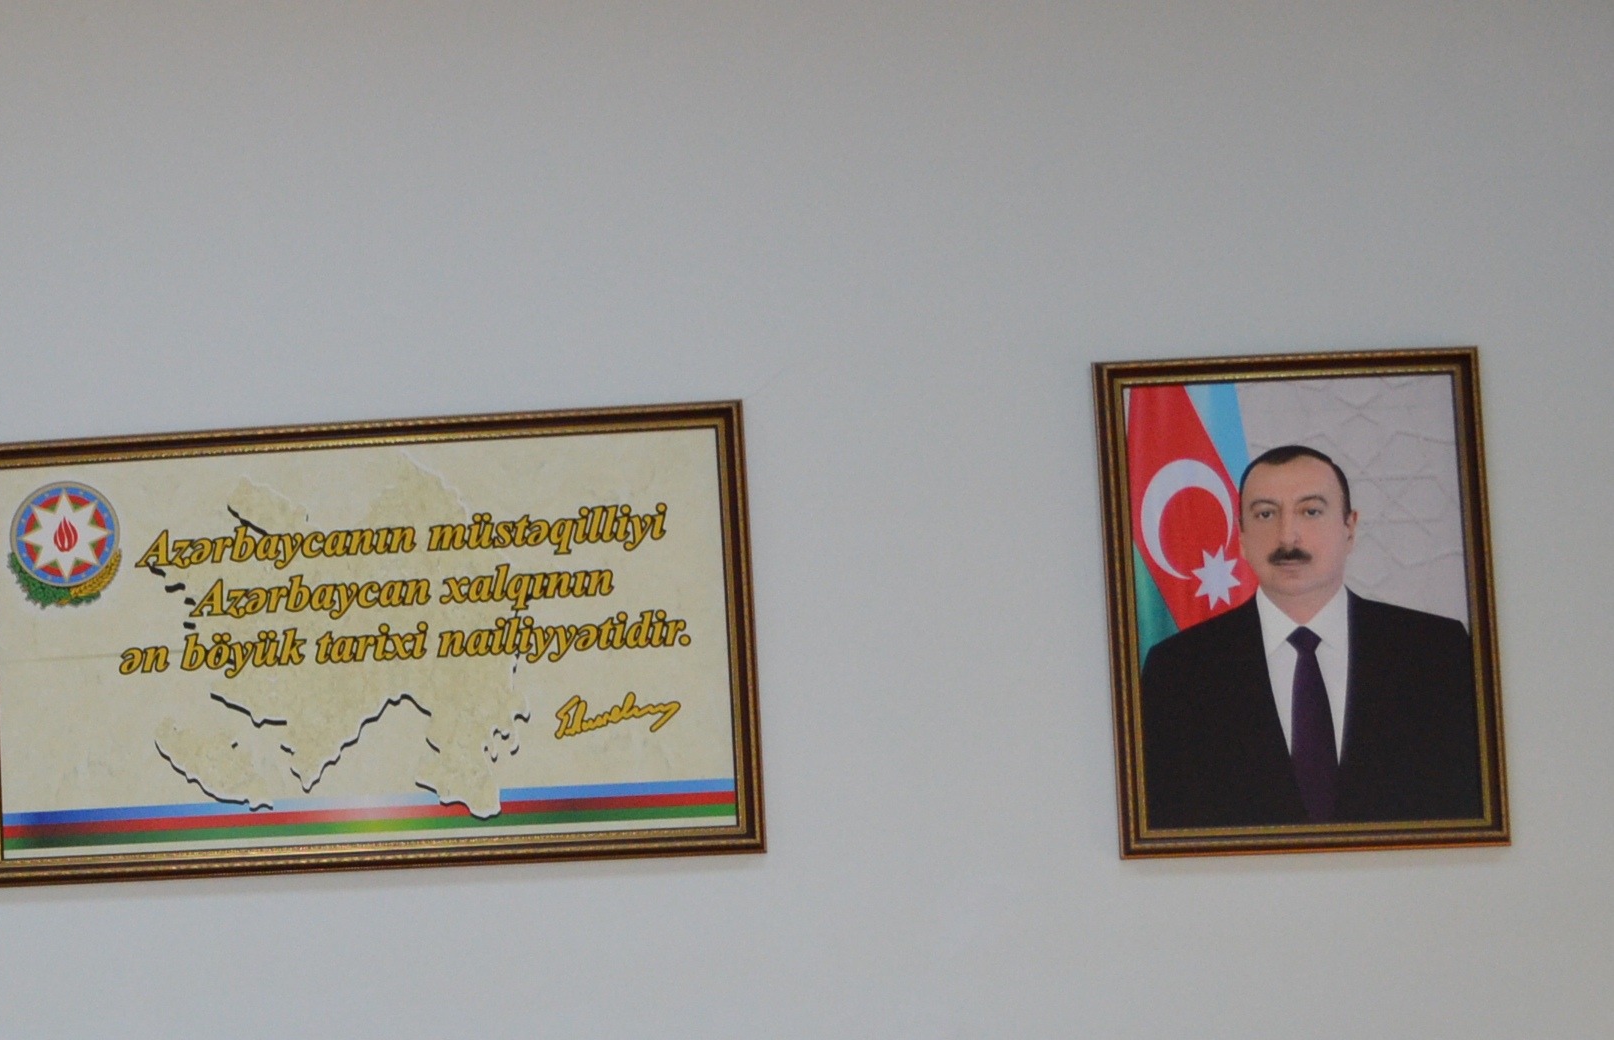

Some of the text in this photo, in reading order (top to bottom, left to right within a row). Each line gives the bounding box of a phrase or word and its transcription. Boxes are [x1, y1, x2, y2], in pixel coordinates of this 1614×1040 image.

[135, 502, 667, 569] Azərbaycanın müstəqilliyi
[190, 563, 614, 619] Azərbaycan xalqının
[119, 609, 691, 678] ən böyük tarixi nailiyyətidir.
